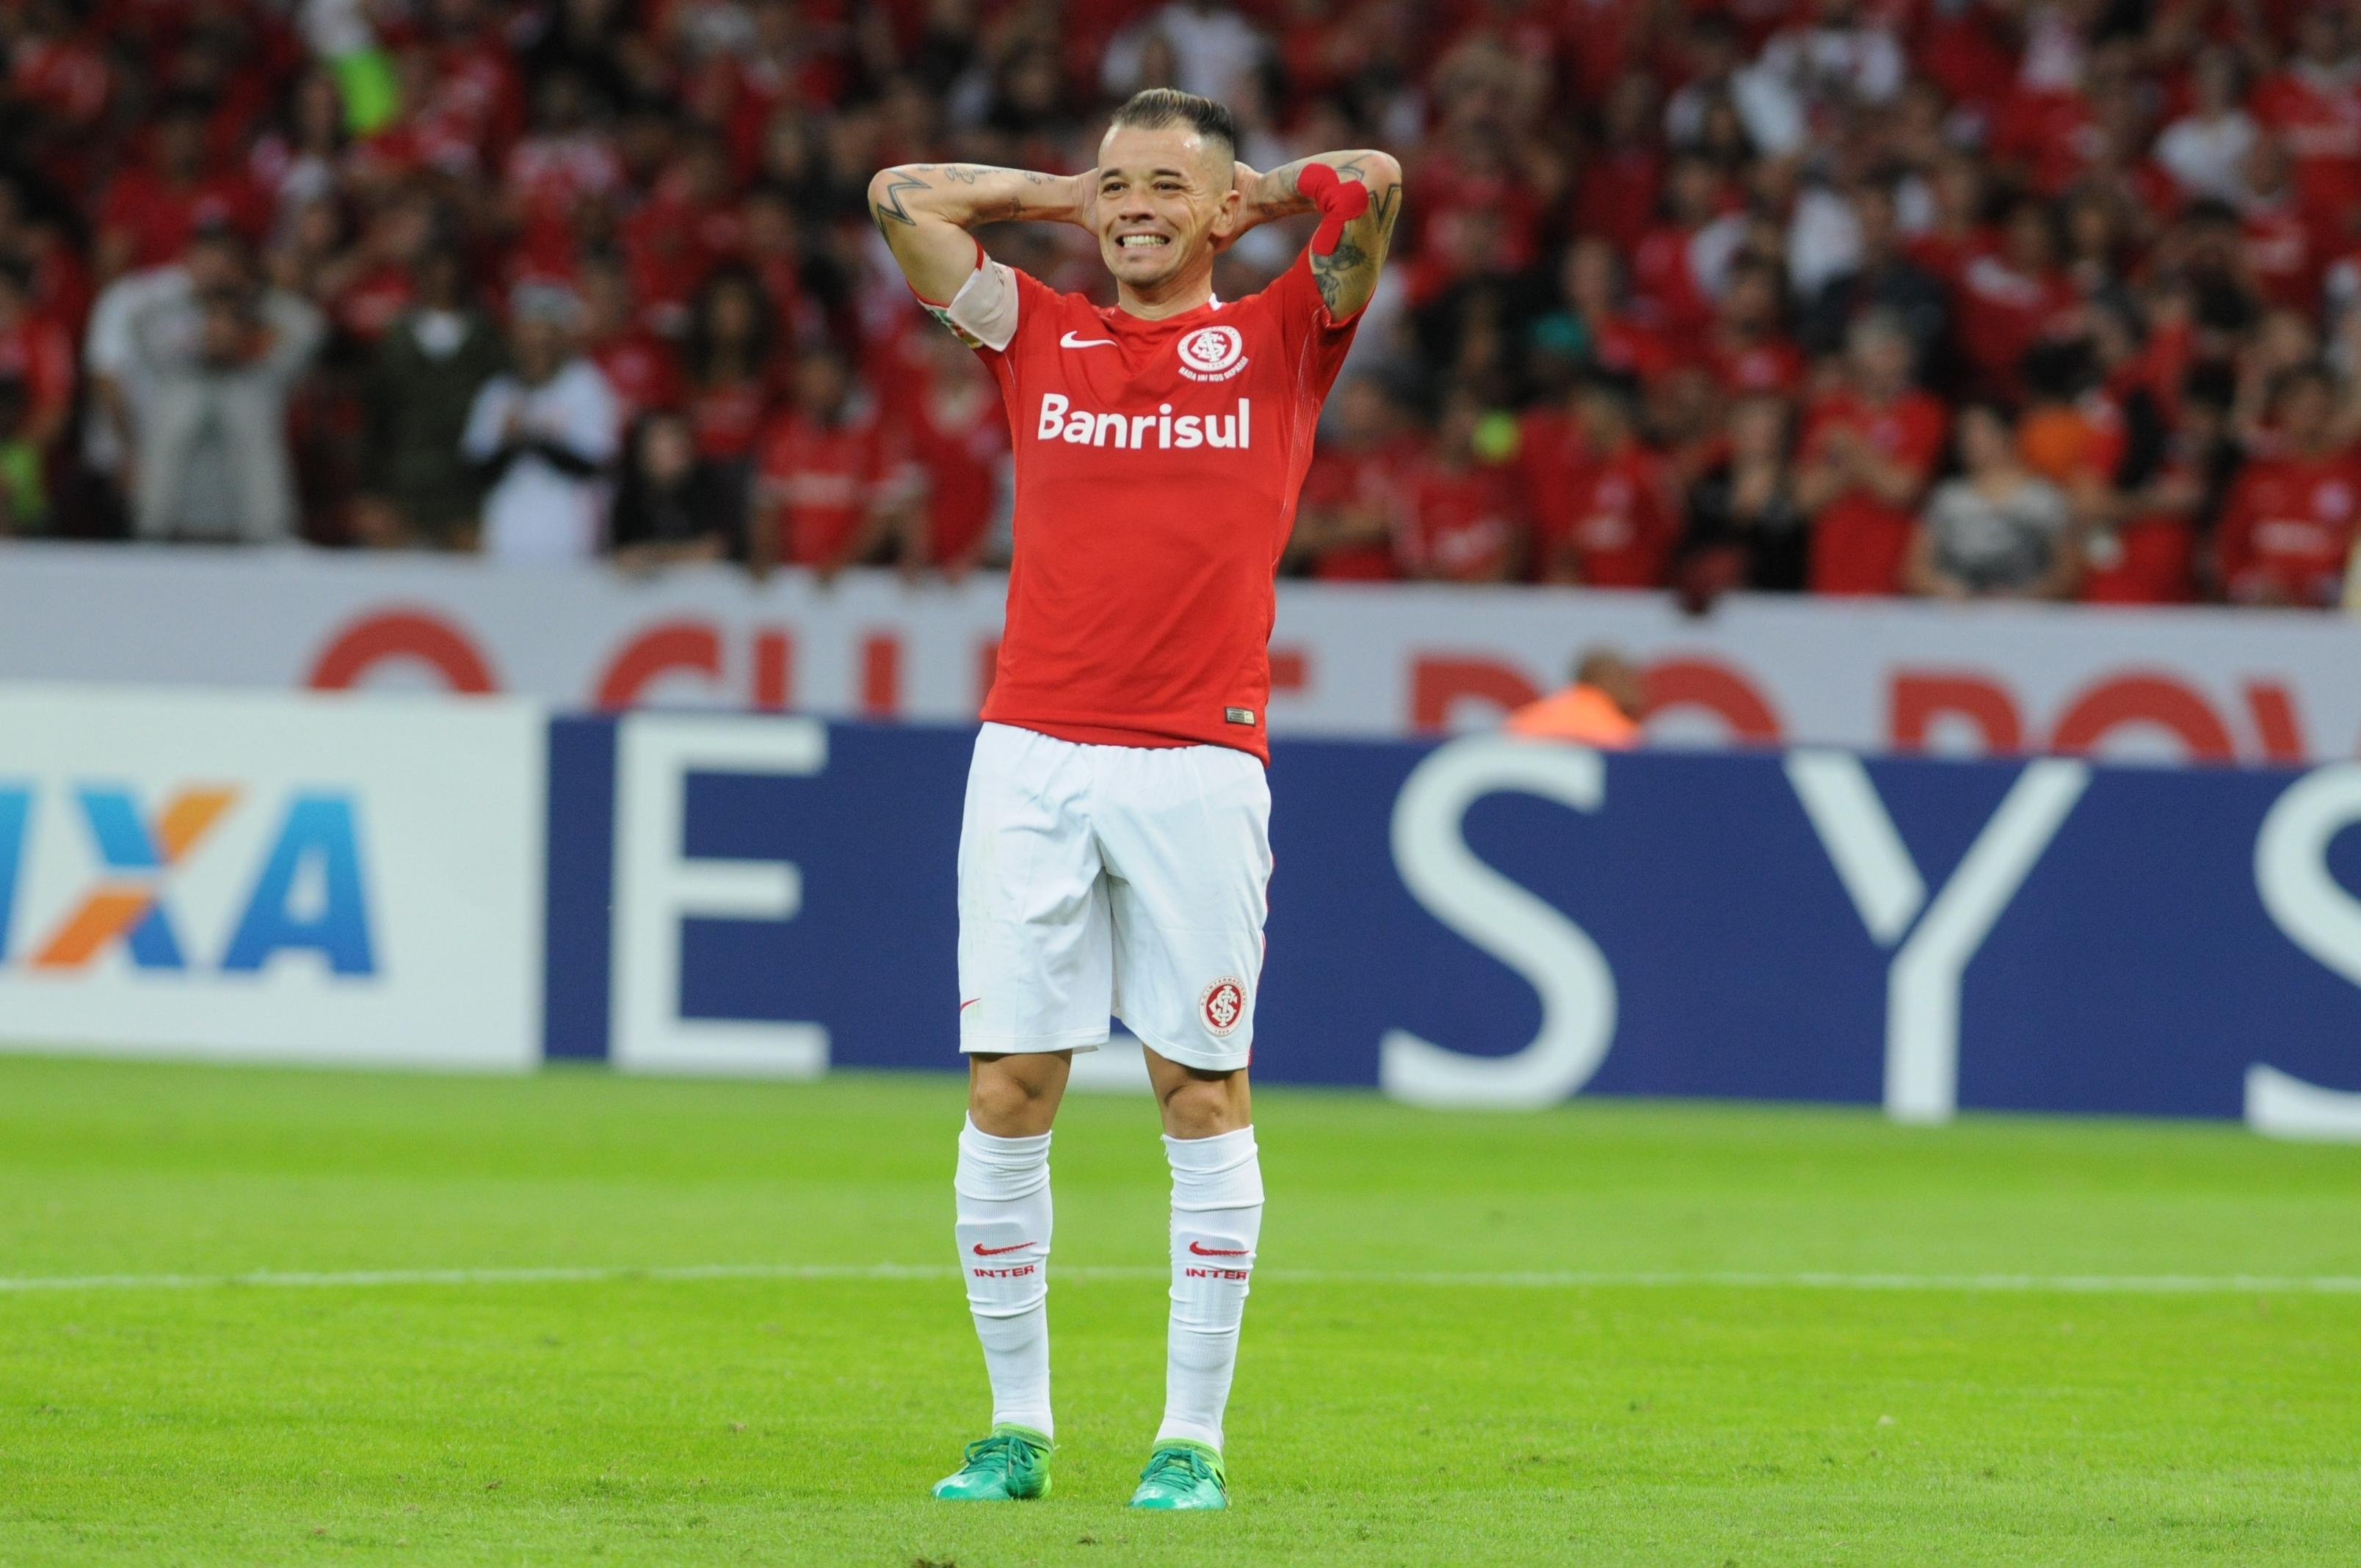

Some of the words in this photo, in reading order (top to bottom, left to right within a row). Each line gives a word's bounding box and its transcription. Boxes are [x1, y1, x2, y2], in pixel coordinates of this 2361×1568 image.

[1037, 393, 1250, 449] Banrisul
[973, 1265, 1034, 1278] INTER
[1186, 1267, 1247, 1280] INTER
